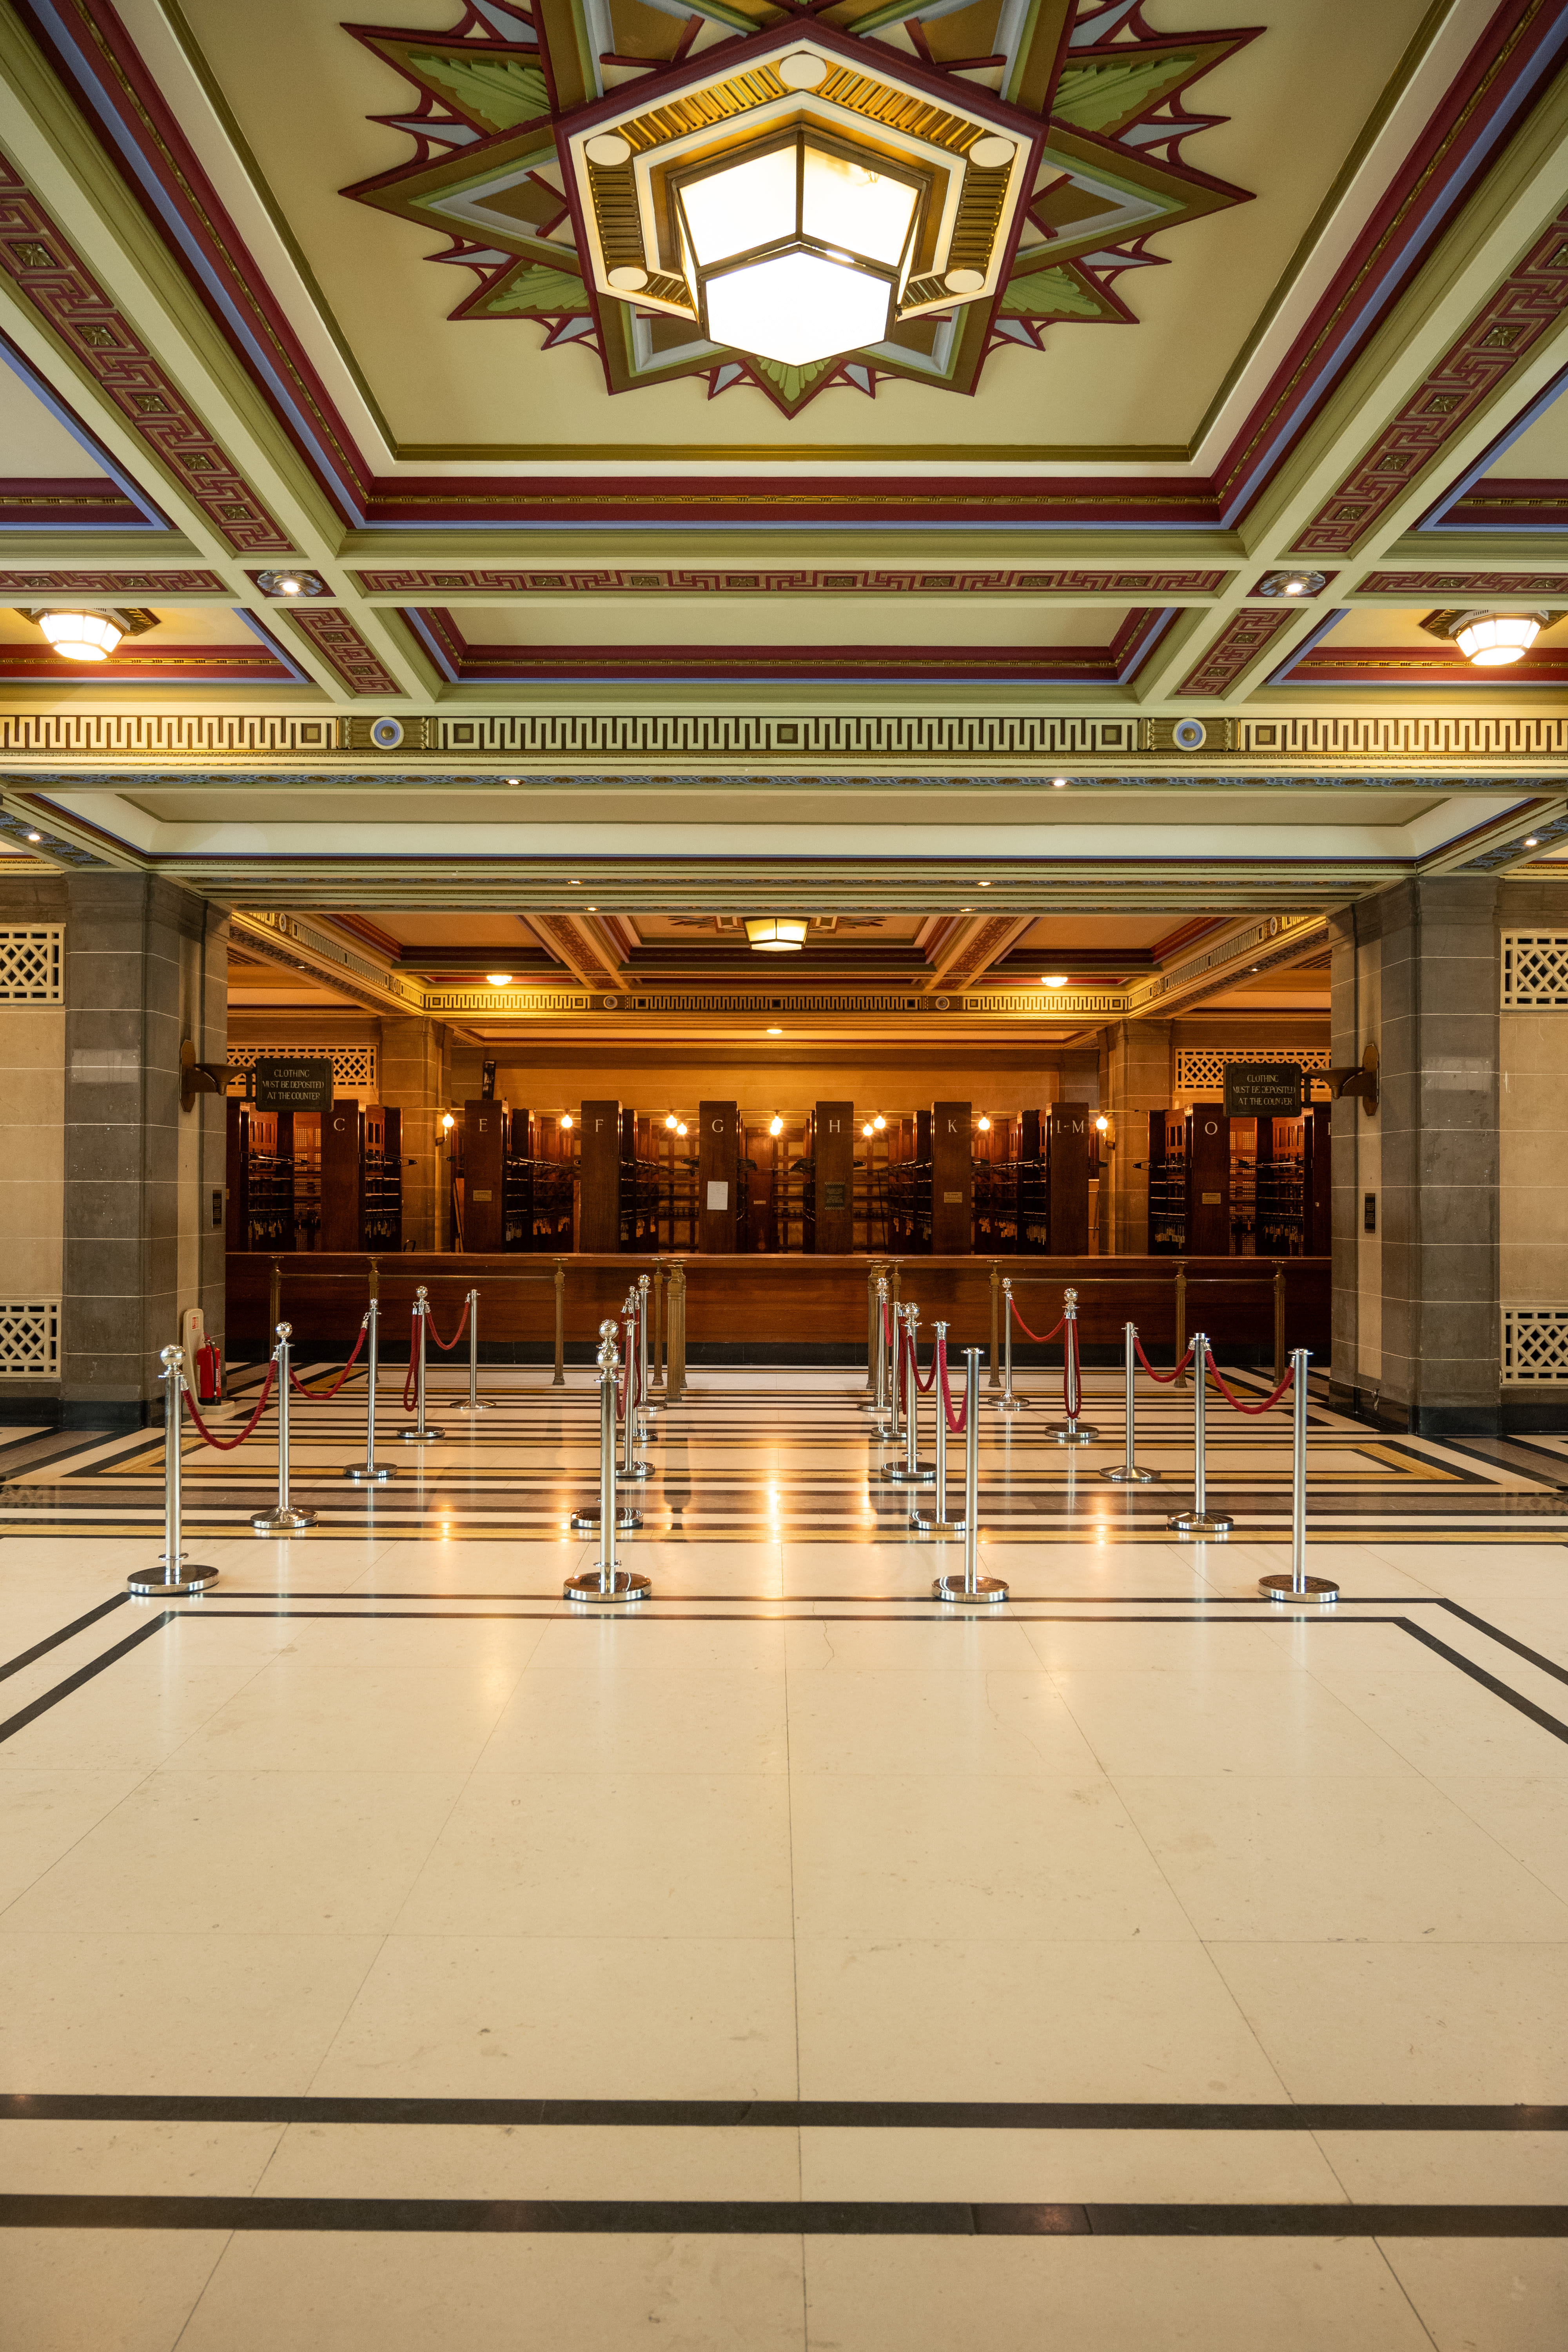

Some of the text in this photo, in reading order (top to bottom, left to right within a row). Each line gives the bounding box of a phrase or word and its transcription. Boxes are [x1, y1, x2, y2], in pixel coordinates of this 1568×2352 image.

[334, 1118, 345, 1131] C
[479, 1119, 488, 1132] E
[595, 1119, 604, 1132] F
[712, 1119, 723, 1132] G
[829, 1120, 840, 1133] H
[948, 1120, 958, 1132] K
[1205, 1122, 1218, 1135] O
